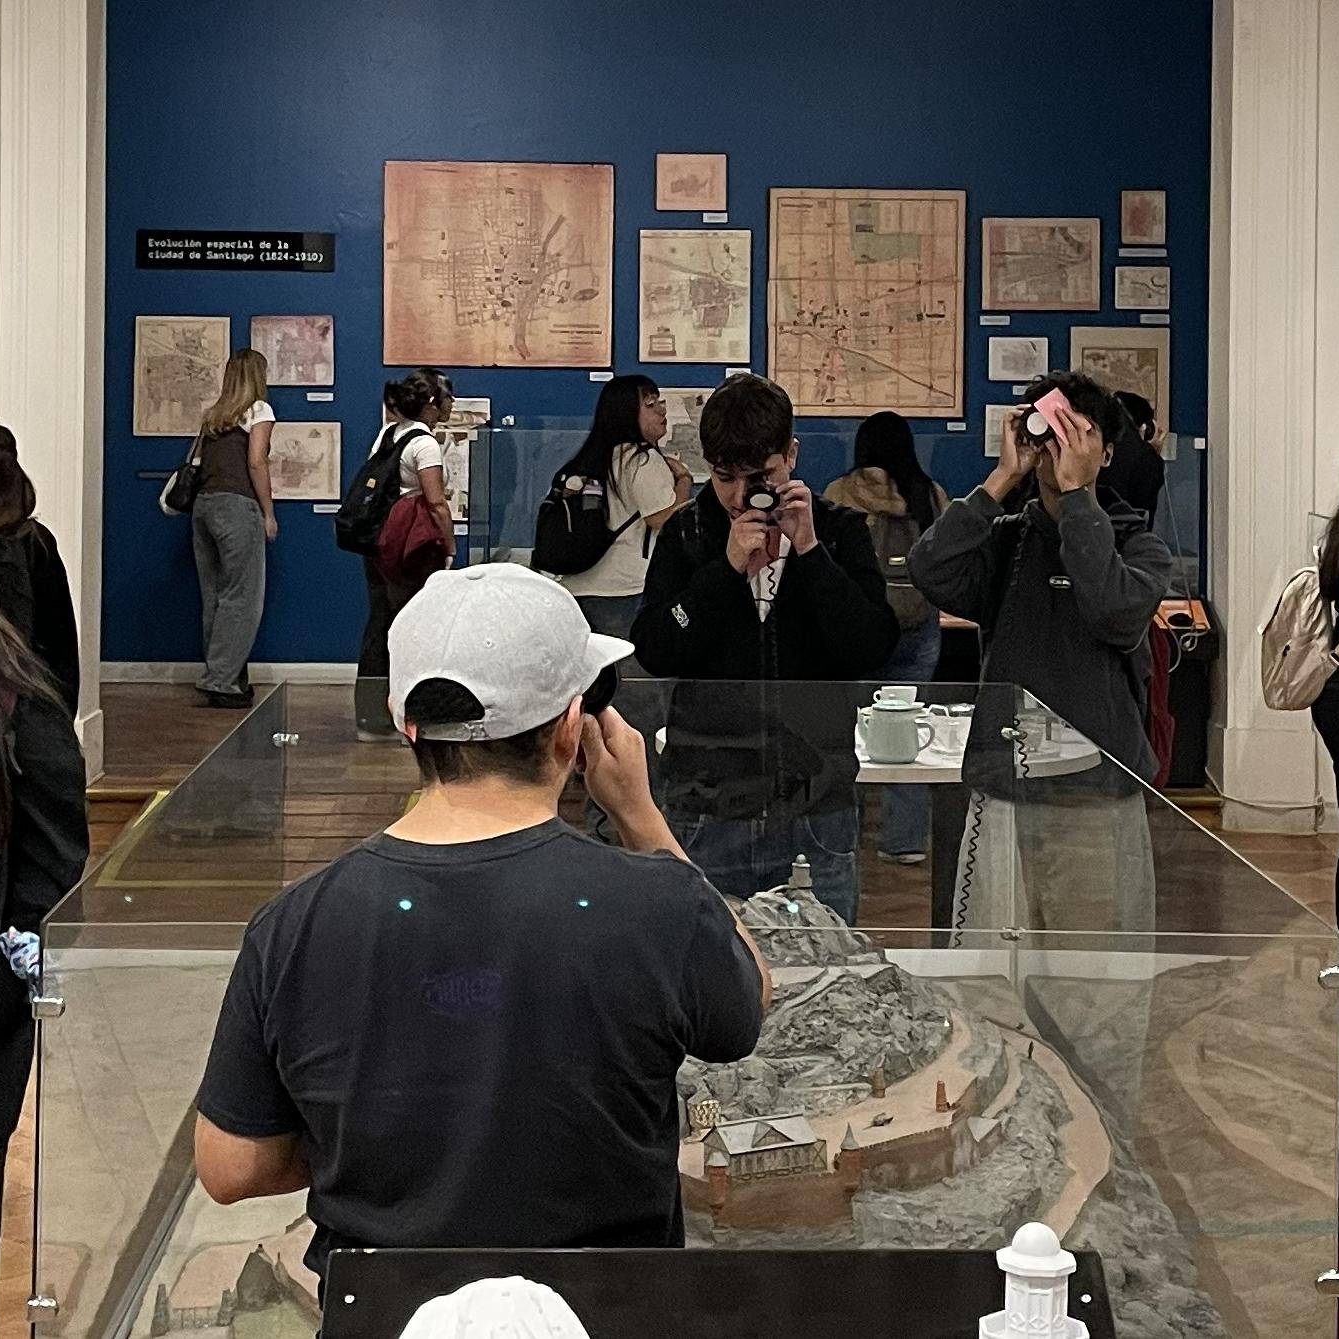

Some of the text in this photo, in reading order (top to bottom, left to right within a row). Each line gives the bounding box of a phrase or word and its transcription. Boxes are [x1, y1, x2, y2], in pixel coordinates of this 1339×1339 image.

[147, 238, 202, 248] Evolución
[259, 240, 272, 249] de
[147, 250, 184, 259] ciudad
[189, 251, 201, 260] de
[206, 250, 254, 262] Santiago
